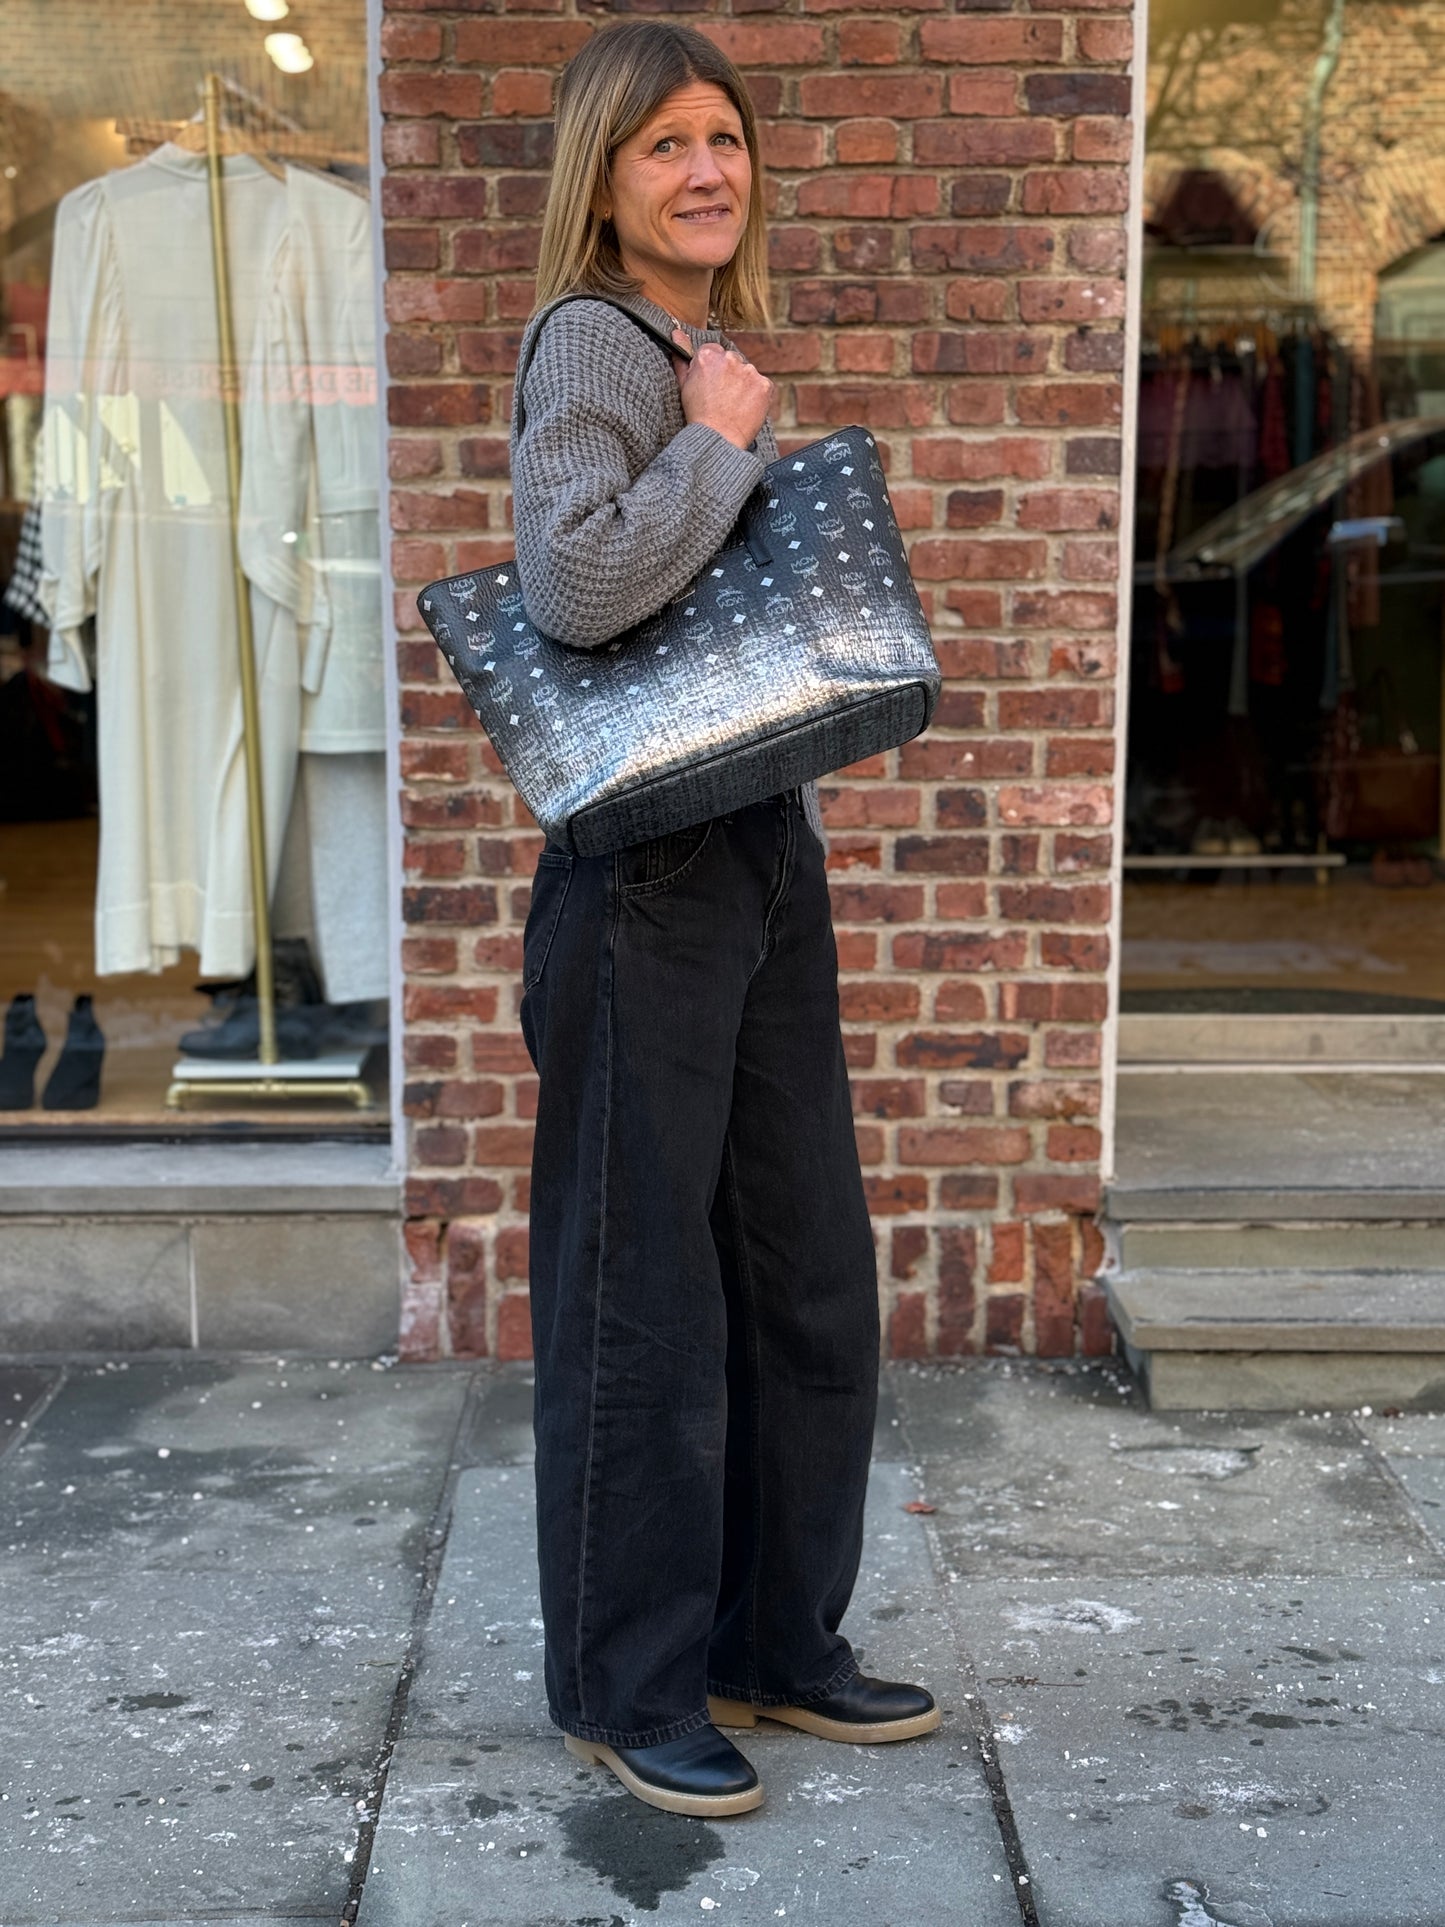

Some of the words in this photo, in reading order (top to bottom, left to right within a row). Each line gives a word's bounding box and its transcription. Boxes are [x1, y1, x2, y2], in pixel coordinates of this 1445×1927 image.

[791, 554, 817, 569] MCM
[448, 578, 476, 592] MCM
[532, 683, 558, 700] MCM
